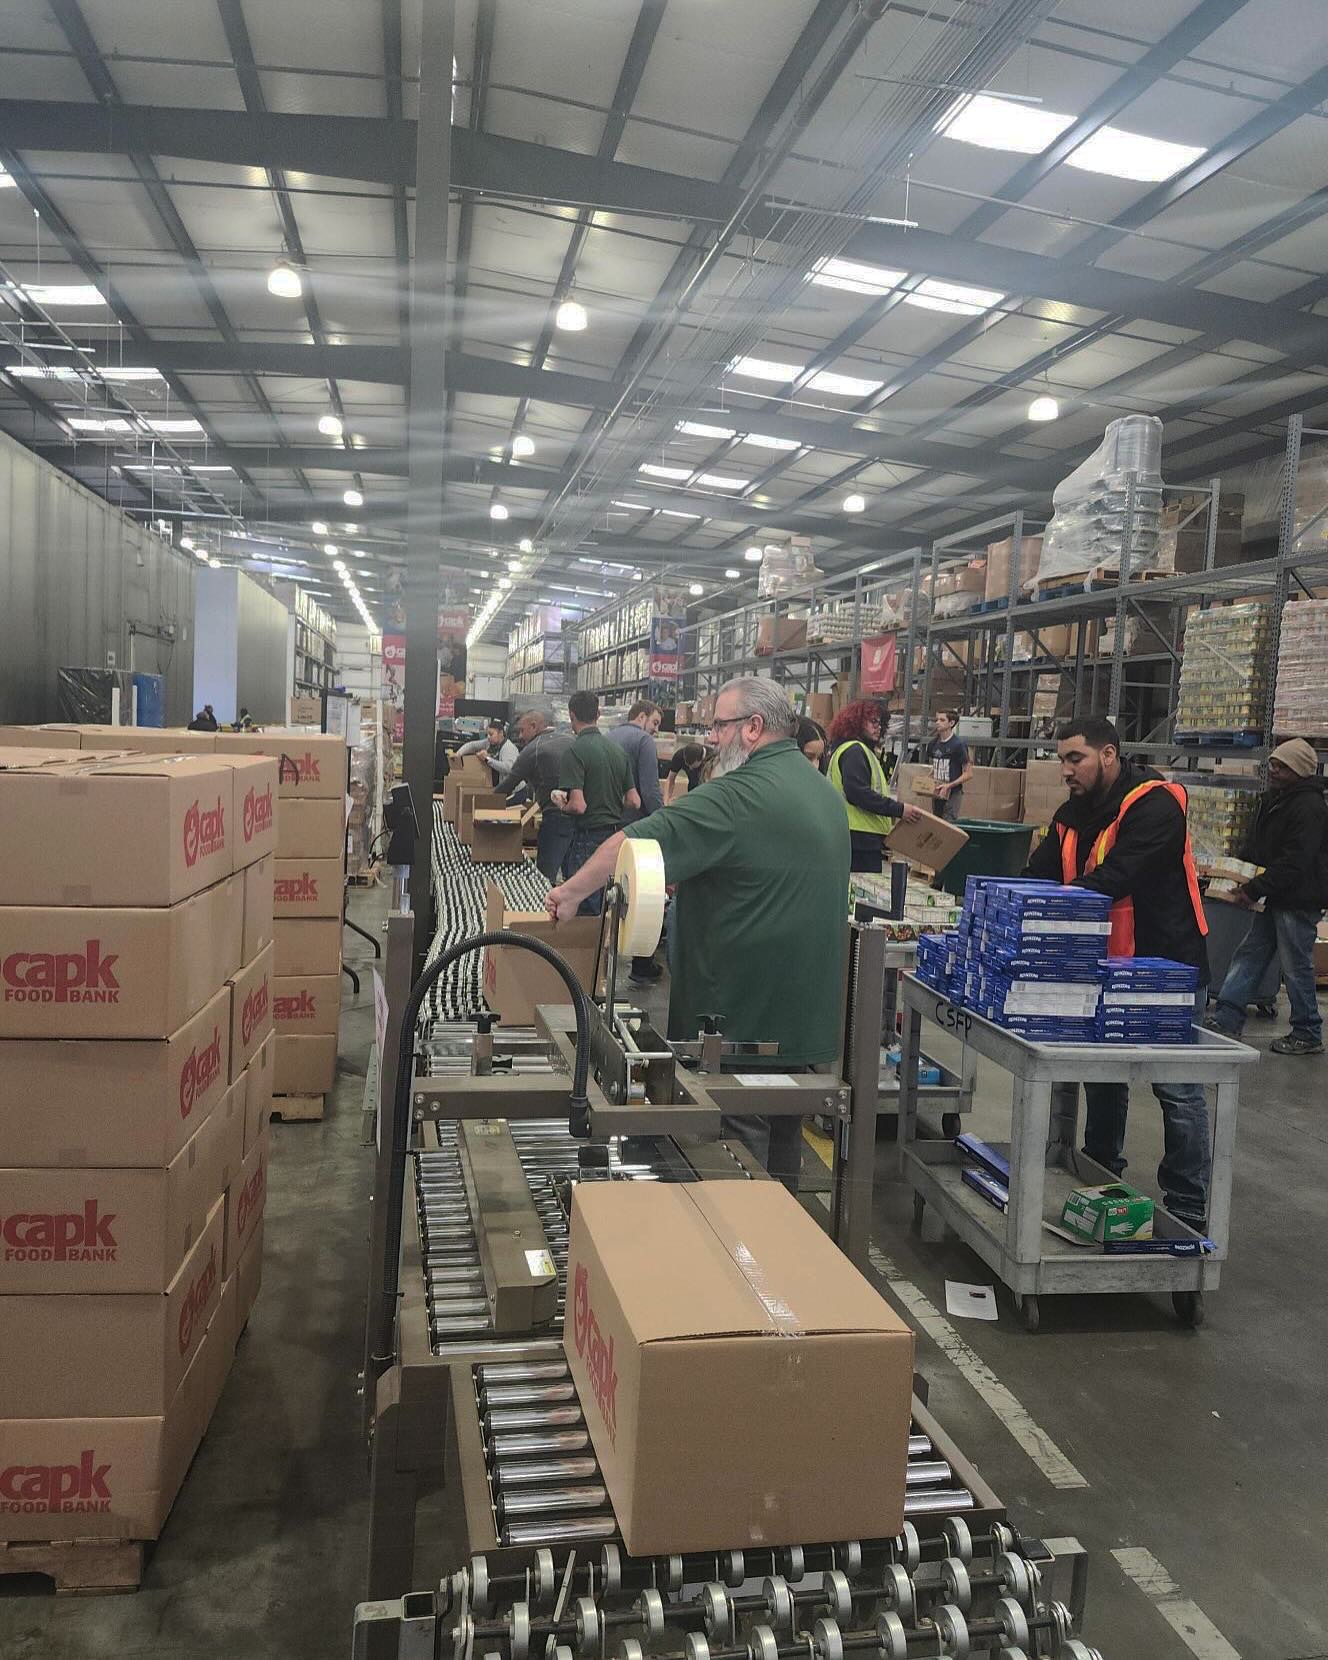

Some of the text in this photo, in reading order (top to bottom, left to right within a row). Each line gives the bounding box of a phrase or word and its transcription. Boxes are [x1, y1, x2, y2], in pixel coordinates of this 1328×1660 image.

[279, 753, 299, 786] A
[200, 795, 225, 844] capk
[2, 939, 120, 1002] capk
[4, 989, 120, 1004] FOOD BANK
[935, 1001, 972, 1040] CSFP
[2, 1199, 118, 1261] capk
[5, 1248, 118, 1262] FOOD BANK
[587, 1308, 618, 1430] capk
[0, 1449, 113, 1513] capk
[0, 1501, 112, 1513] FOOD BANK
